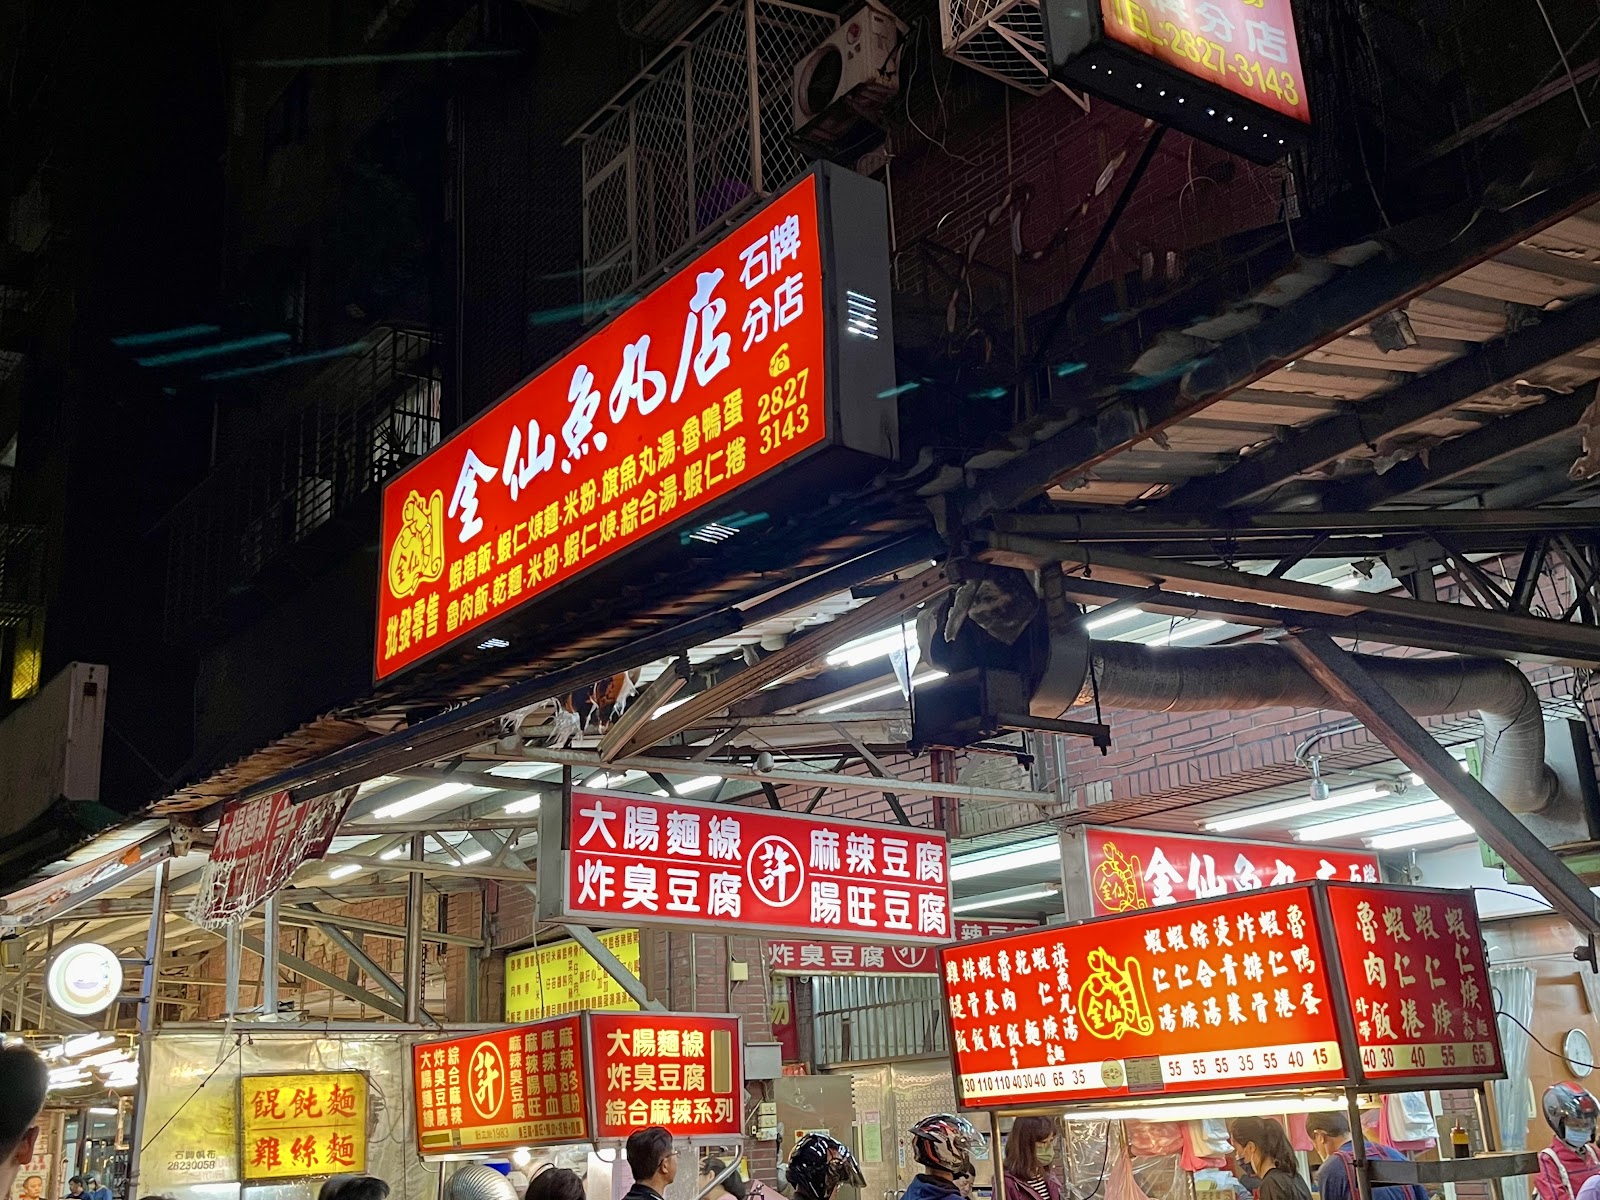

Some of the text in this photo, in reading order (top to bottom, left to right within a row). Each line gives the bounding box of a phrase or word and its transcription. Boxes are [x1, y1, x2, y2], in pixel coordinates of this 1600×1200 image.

[739, 214, 801, 291] 石牌
[742, 272, 804, 353] 分店
[448, 267, 732, 544] 金仙魚丸店
[757, 367, 809, 425] 2827
[759, 403, 809, 455] 3143
[384, 591, 440, 661] 批發零售
[578, 800, 743, 862] 大腸麵線
[757, 842, 798, 904] 許
[809, 827, 944, 885] 麻辣豆腐
[577, 858, 743, 919] 炸臭豆腐
[809, 880, 947, 936] 腸旺豆腐
[769, 942, 885, 969] 炸臭豆腐
[1190, 920, 1222, 1027] 綜合湯
[1236, 912, 1269, 1024] 炸排骨
[1286, 904, 1323, 1015] 魯鴨蛋
[1356, 900, 1399, 1040] 魯肉飯
[998, 950, 1024, 1047] 魯肉飯
[1144, 928, 1178, 1033] 蝦仁湯
[1087, 995, 1122, 1029] 金仙
[606, 1028, 705, 1058] 大腸麵線
[1263, 1052, 1278, 1069] 55
[1288, 1050, 1304, 1068] 40
[1312, 1047, 1328, 1065] 15
[1363, 1048, 1376, 1069] 40
[1381, 1047, 1394, 1068] 30
[1411, 1046, 1426, 1067] 40
[1441, 1045, 1455, 1066] 55
[1472, 1044, 1487, 1065] 65
[474, 1051, 499, 1112] 許
[508, 1035, 526, 1120] 麻辣臭豆腐
[524, 1032, 542, 1117] 麻辣腸旺
[541, 1029, 560, 1116] 麻辣鴨血
[607, 1062, 705, 1092] 炸臭豆腐
[1012, 1074, 1022, 1089] 40
[1023, 1073, 1033, 1088] 30
[1034, 1072, 1046, 1087] 40
[1053, 1071, 1064, 1087] 65
[1072, 1069, 1086, 1085] 35
[1168, 1060, 1182, 1077] 55
[1192, 1058, 1206, 1075] 55
[1214, 1056, 1229, 1073] 55
[1238, 1054, 1254, 1072] 35
[420, 1051, 435, 1128] 大腸麵線
[433, 1048, 448, 1127] 炸臭豆腐
[447, 1045, 463, 1125] 綜合麻辣
[978, 1076, 993, 1091] 110
[995, 1075, 1011, 1090] 110
[251, 1083, 357, 1121] 餛飩麵
[605, 1097, 734, 1126] 綜合麻辣系列
[167, 1160, 216, 1171] 28230058
[250, 1132, 356, 1172] 雞絲麵
